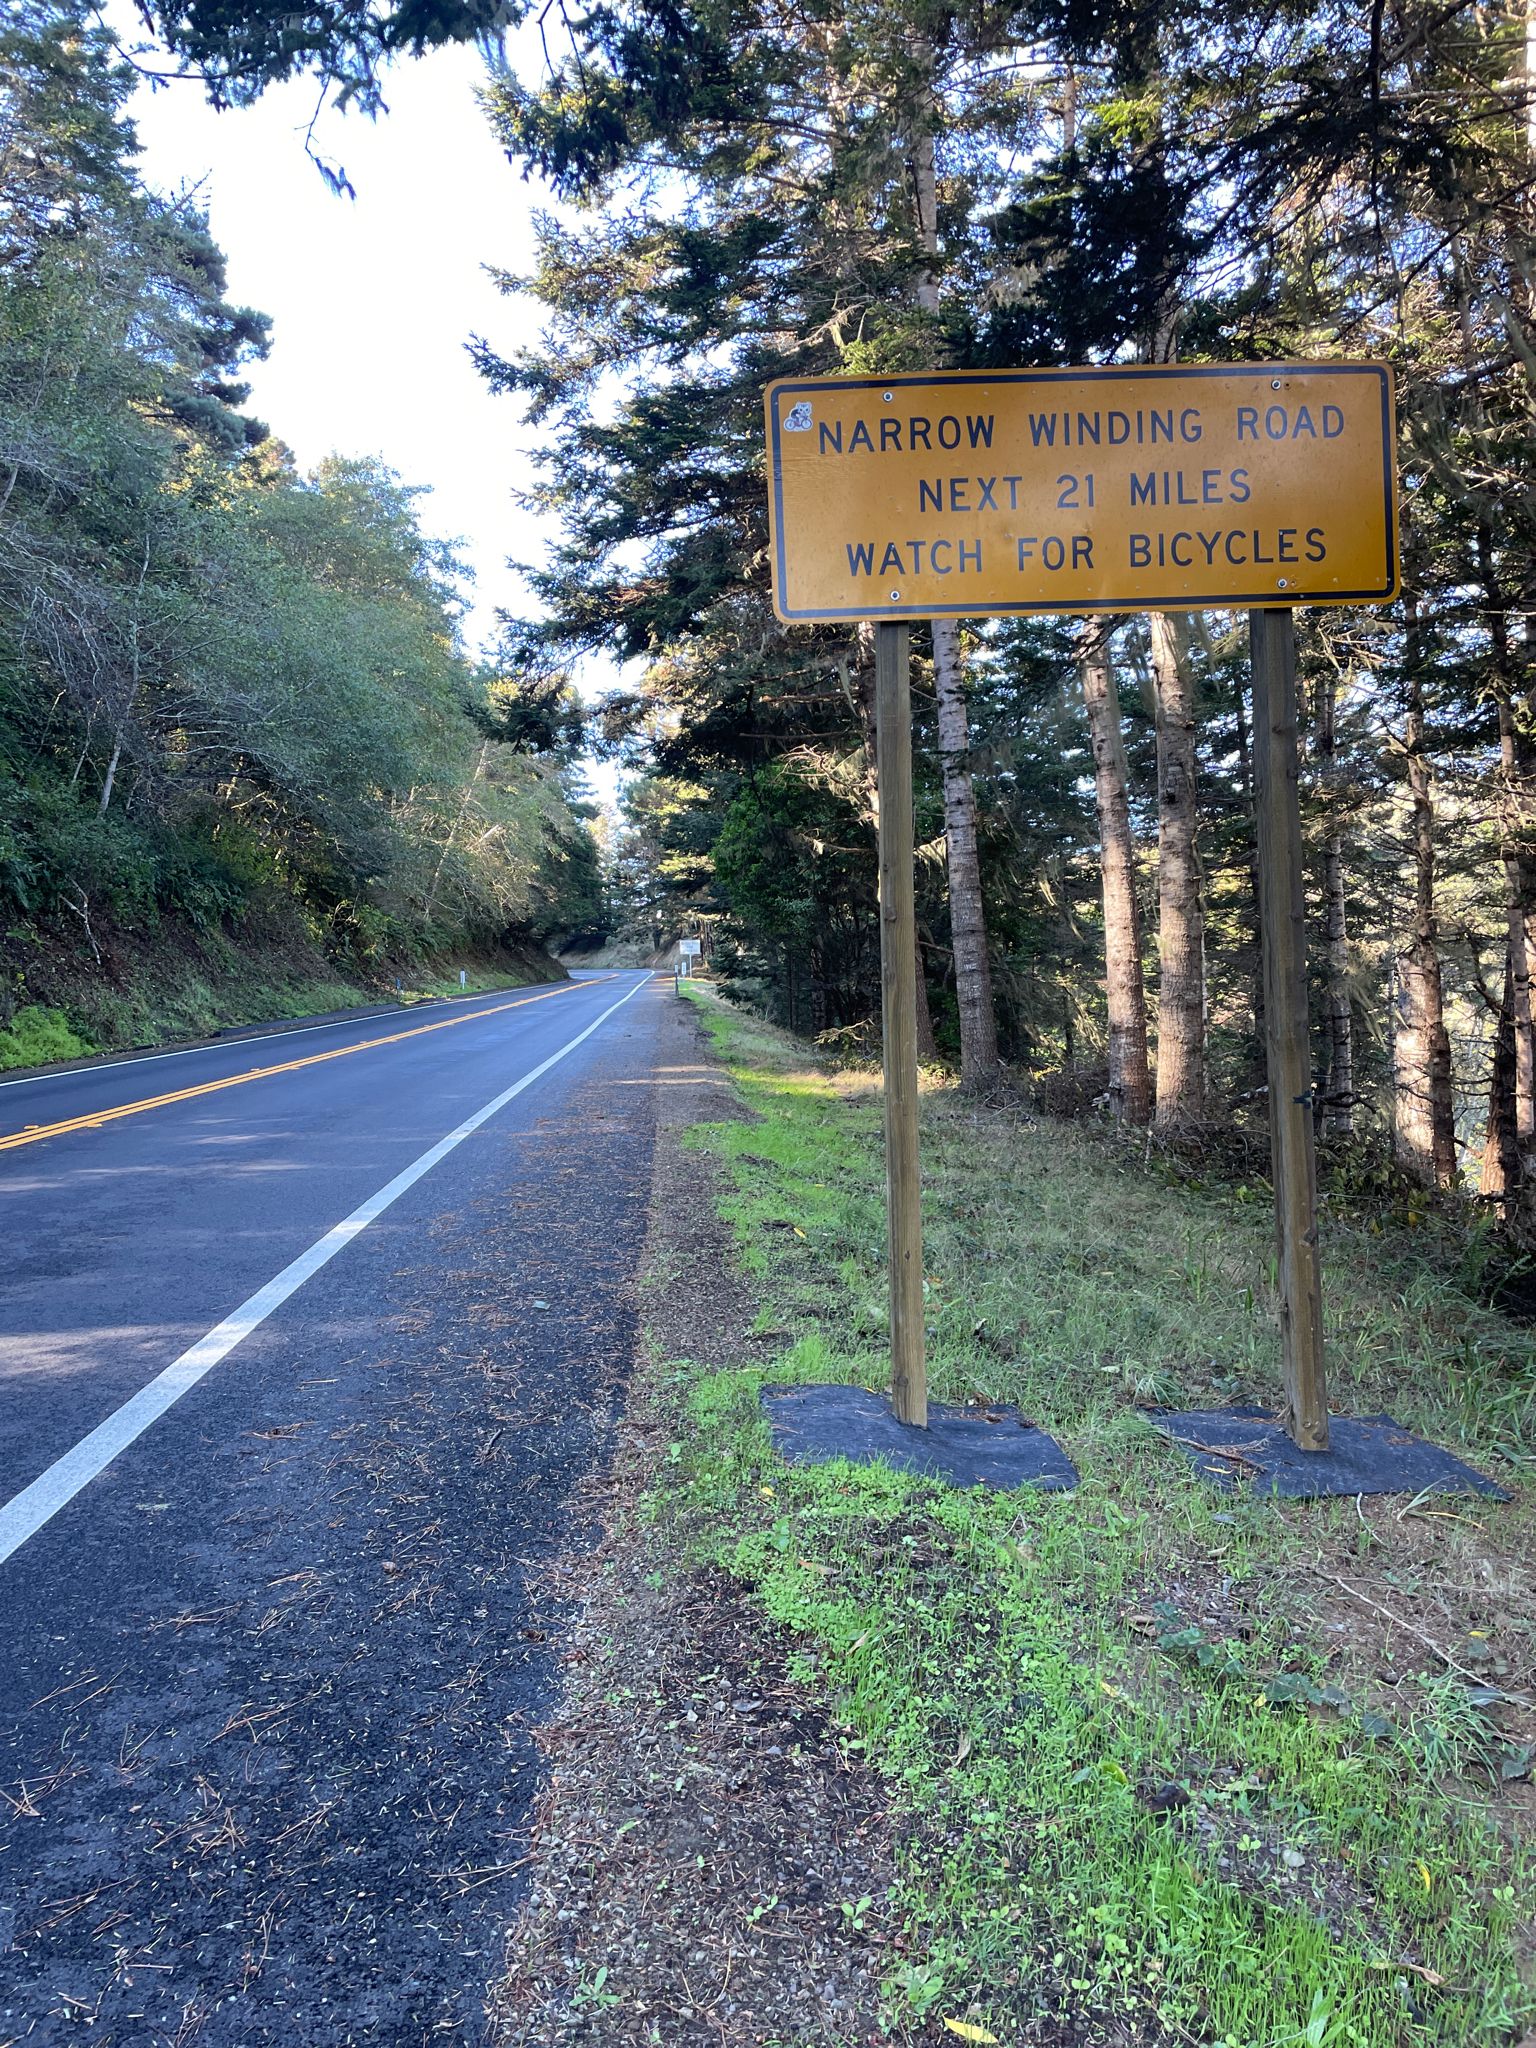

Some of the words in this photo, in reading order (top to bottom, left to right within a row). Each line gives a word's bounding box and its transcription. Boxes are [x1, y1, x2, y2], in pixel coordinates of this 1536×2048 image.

[819, 416, 994, 453] NARROW
[1029, 408, 1203, 447] WINDING
[1237, 405, 1344, 441] ROAD
[920, 476, 1023, 512] NEXT
[1056, 474, 1094, 509] 21
[1130, 468, 1251, 505] MILES
[846, 539, 982, 576] WATCH
[1017, 535, 1093, 572] FOR
[1129, 528, 1326, 568] BICYCLES
